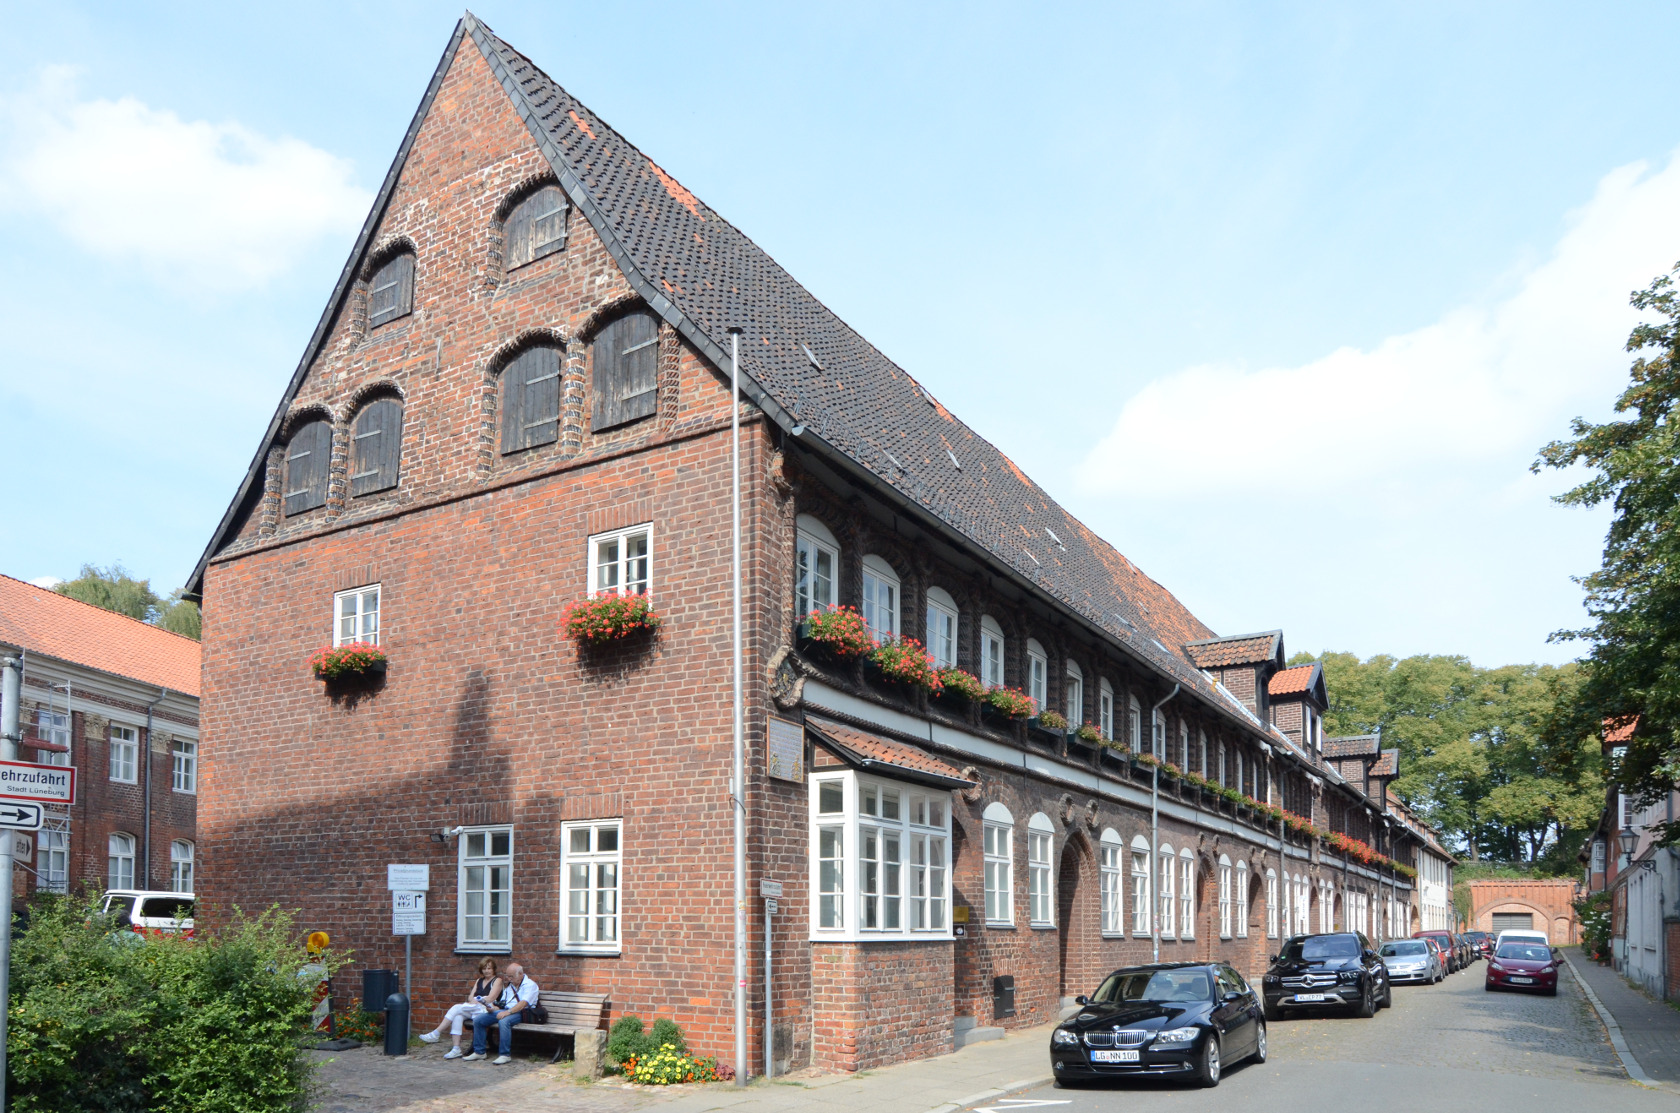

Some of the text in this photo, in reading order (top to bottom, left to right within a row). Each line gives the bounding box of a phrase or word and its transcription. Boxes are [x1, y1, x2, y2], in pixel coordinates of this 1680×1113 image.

[0, 769, 65, 786] ehrzufahrt
[7, 785, 65, 797] Stadt Lüneburg
[1095, 1052, 1138, 1060] LG NN 100
